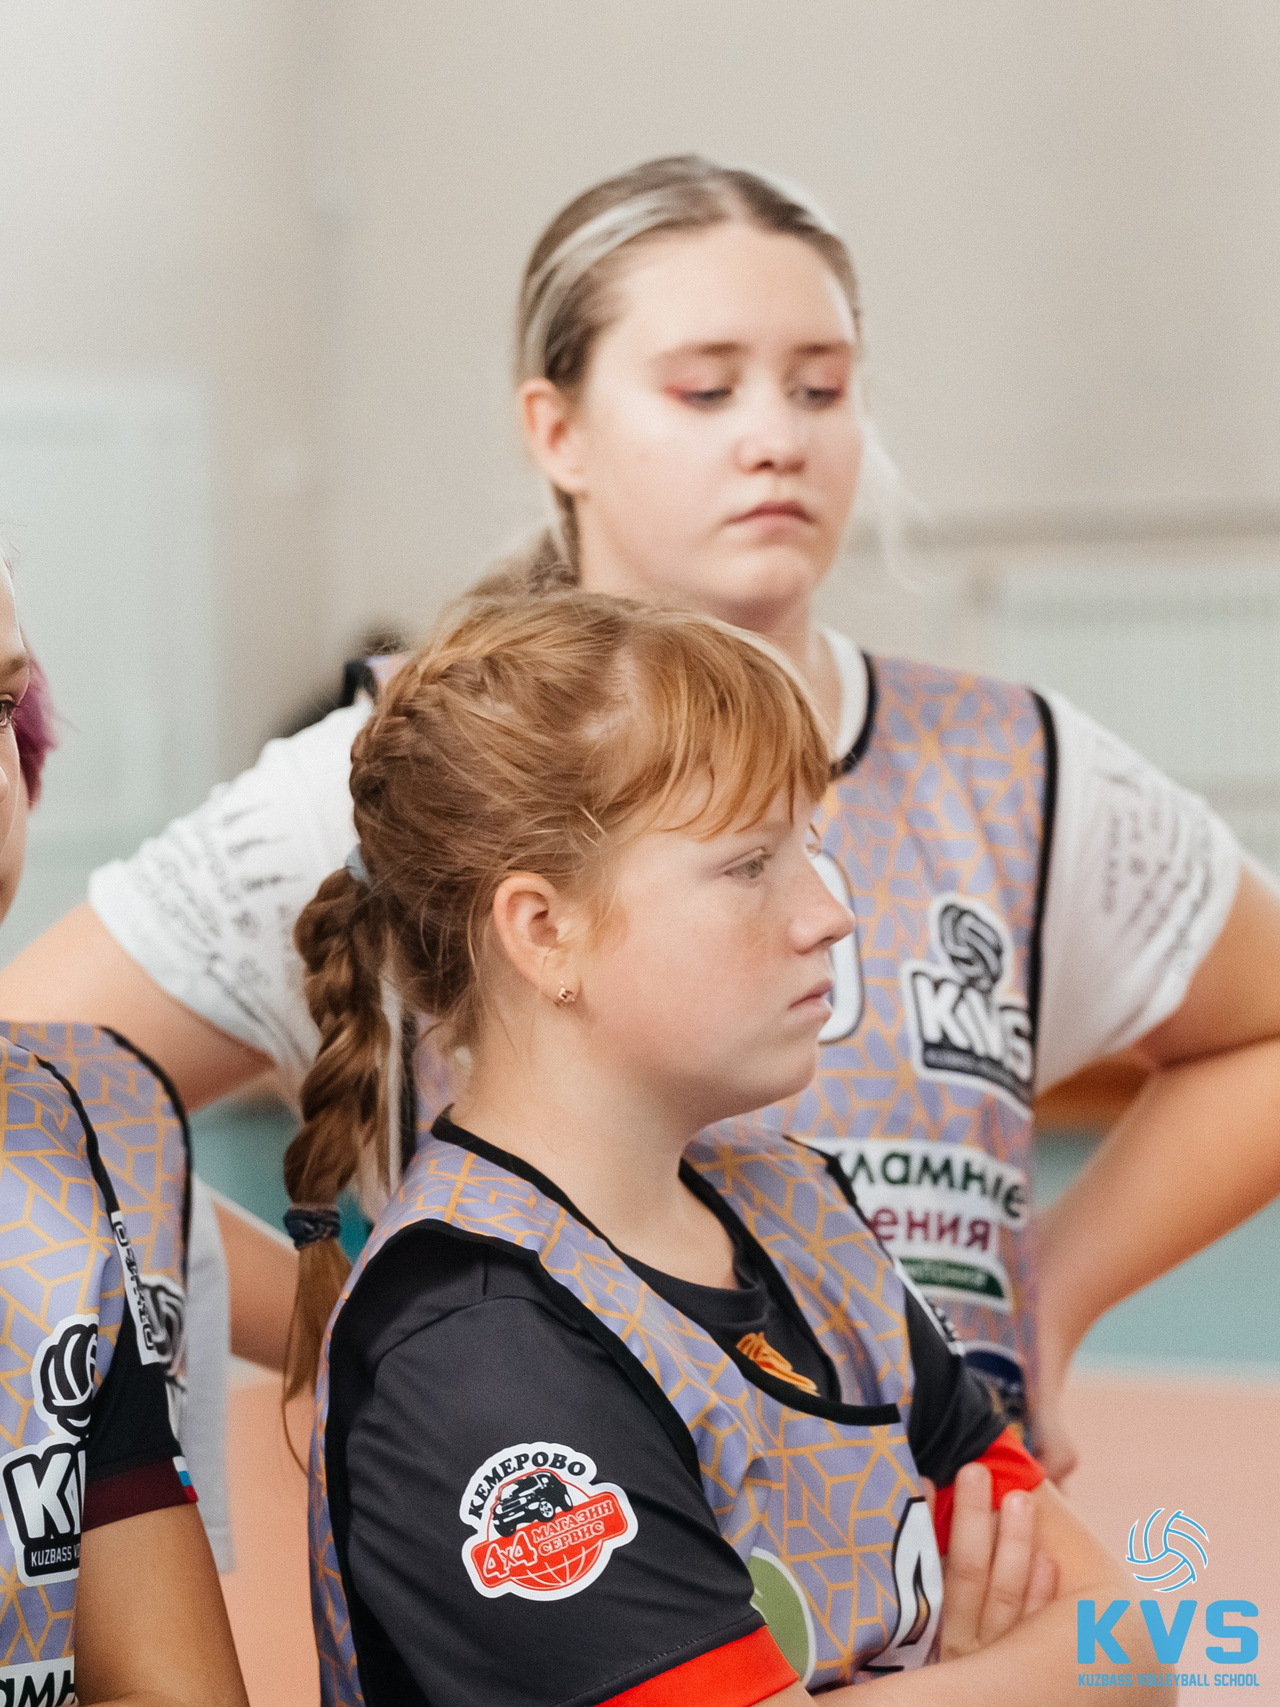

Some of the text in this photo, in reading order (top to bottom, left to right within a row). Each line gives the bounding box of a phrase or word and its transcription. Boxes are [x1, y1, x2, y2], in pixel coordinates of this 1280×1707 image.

[914, 976, 1032, 1081] KVS
[468, 1451, 587, 1520] КЕМЕРОВО
[531, 1499, 616, 1544] МАГАЗИН
[537, 1520, 606, 1557] СЕРВИС
[31, 1545, 73, 1567] KUZBASS
